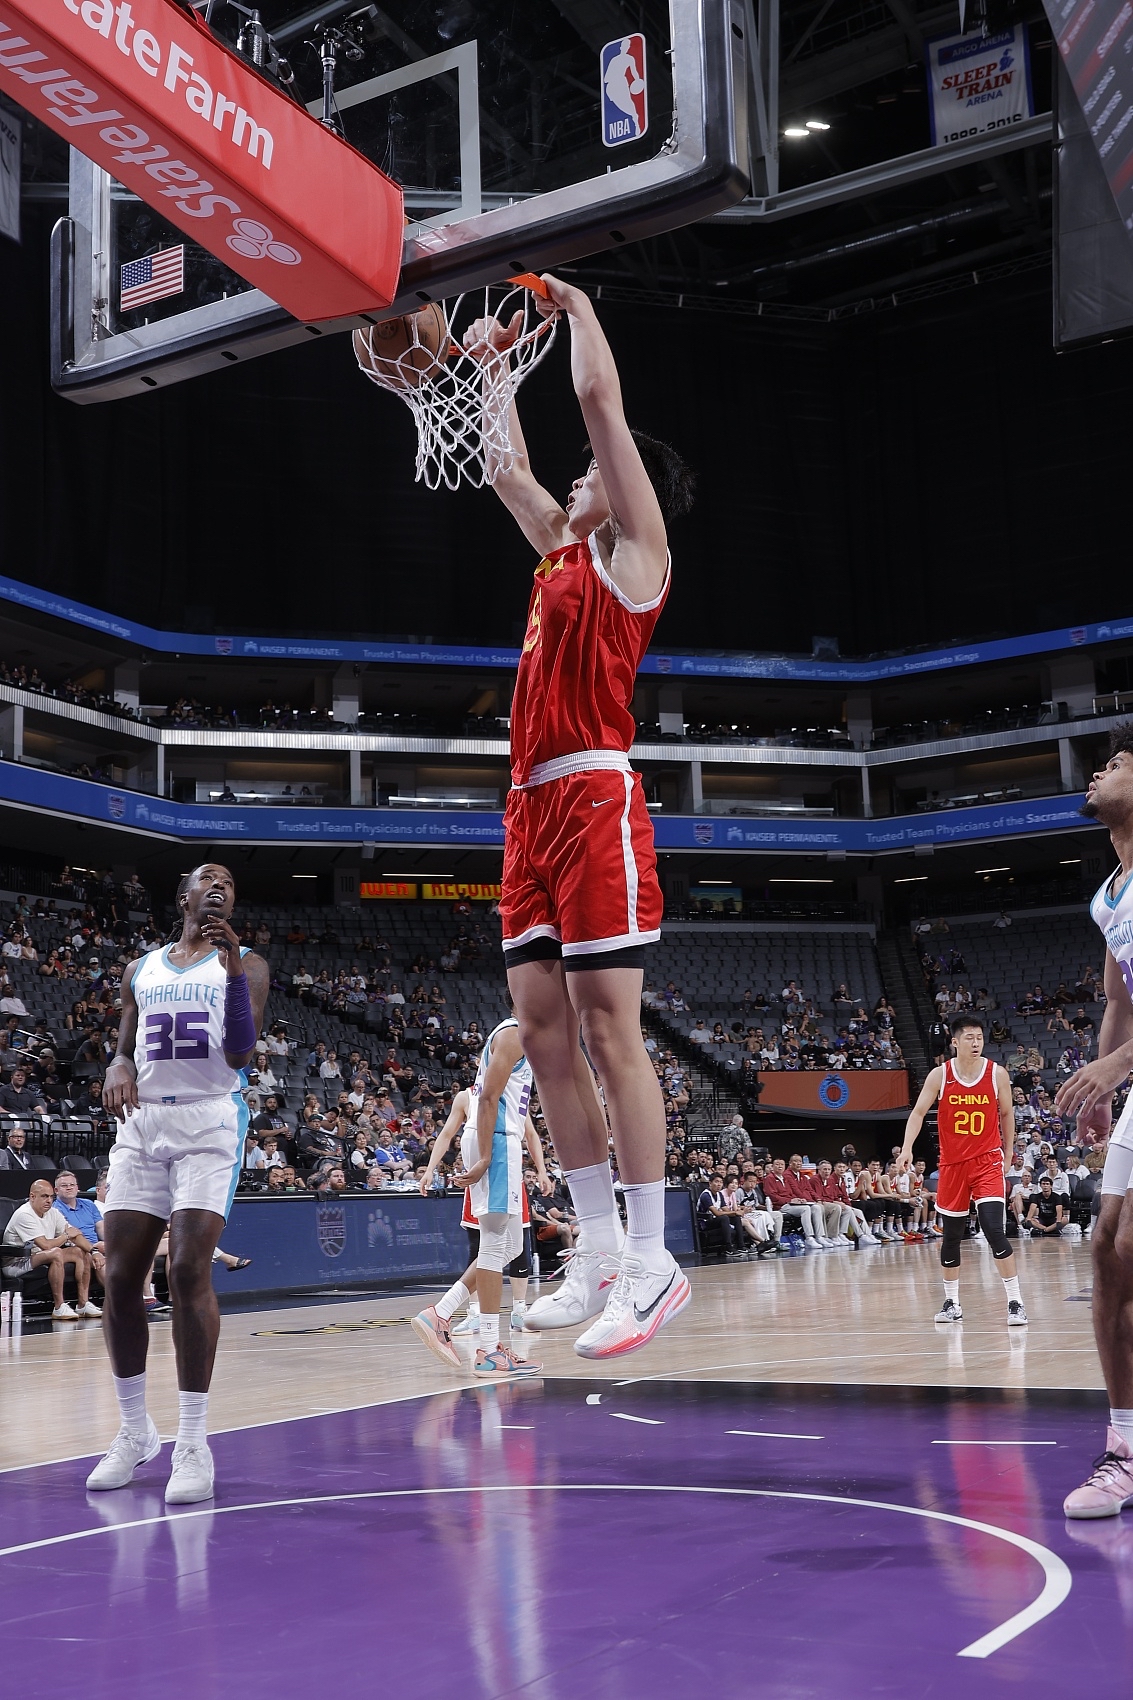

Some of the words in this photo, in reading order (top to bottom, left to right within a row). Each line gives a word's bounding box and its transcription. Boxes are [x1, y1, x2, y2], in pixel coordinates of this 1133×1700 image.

[941, 62, 998, 91] SLEEP
[955, 69, 1015, 101] TRAIN
[163, 41, 274, 170] Farm
[965, 89, 1004, 109] ARENA
[609, 118, 631, 140] NBA
[99, 124, 242, 218] State
[260, 645, 287, 654] KAISER
[288, 646, 341, 656] PERMANENTE
[363, 649, 395, 660] Trusted
[397, 651, 420, 660] Team
[420, 652, 464, 662] Physicians
[465, 653, 475, 662] of
[475, 654, 490, 663] the
[904, 656, 954, 671] Sacramento
[954, 652, 980, 665] Kings
[276, 820, 320, 832] Trusted
[321, 821, 353, 833] Team
[354, 822, 413, 836] Physicians
[415, 823, 429, 834] of
[429, 823, 448, 835] the
[745, 832, 777, 842] KAISER
[778, 833, 840, 843] PERMANENTE
[865, 830, 904, 844] Trusted
[906, 827, 935, 840] Team
[935, 820, 991, 837] Physicians
[992, 817, 1005, 829] of
[1005, 815, 1026, 827] the
[341, 876, 355, 892] 110
[139, 982, 220, 1010] CHARLOTTE
[145, 1011, 210, 1063] 35
[948, 1094, 990, 1105] CHINA
[954, 1110, 986, 1136] 20
